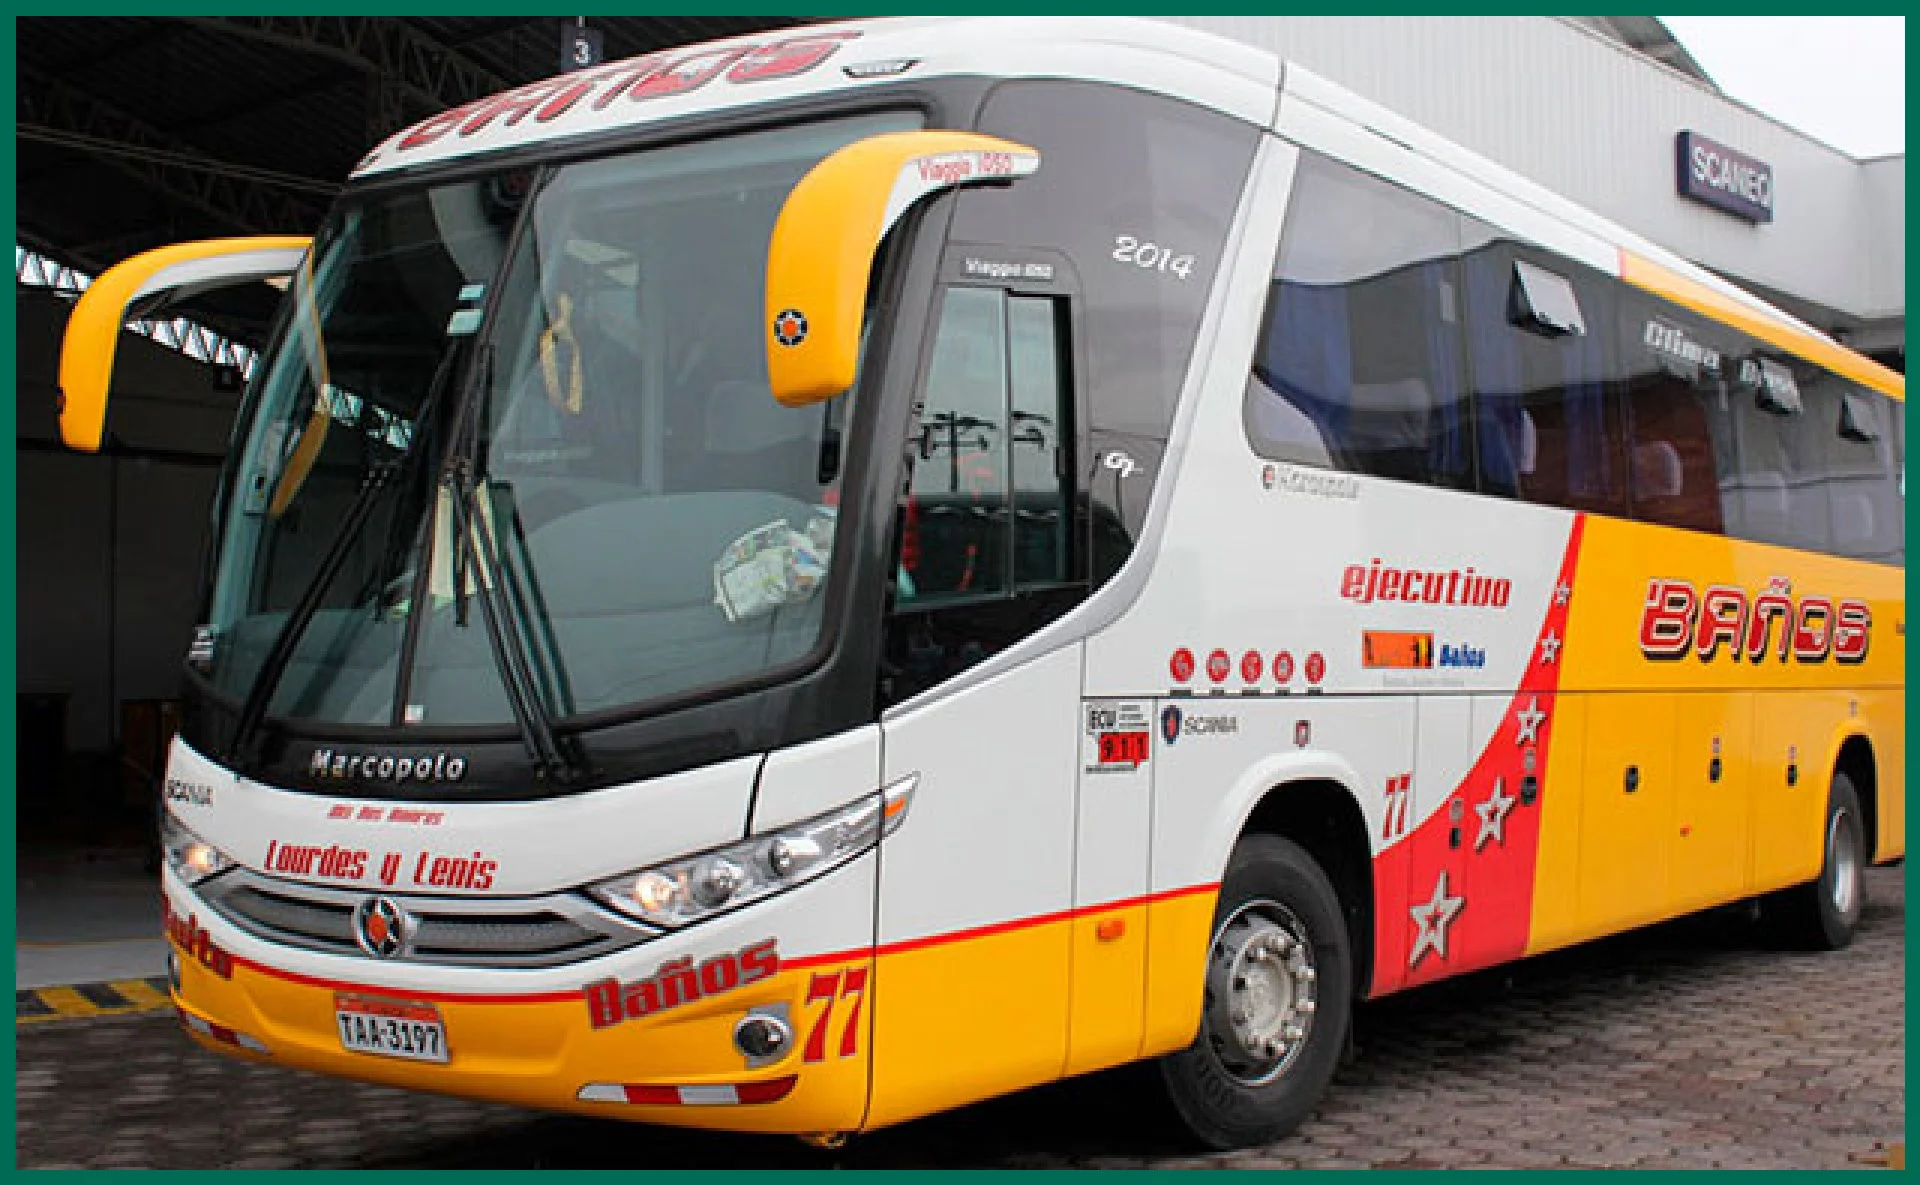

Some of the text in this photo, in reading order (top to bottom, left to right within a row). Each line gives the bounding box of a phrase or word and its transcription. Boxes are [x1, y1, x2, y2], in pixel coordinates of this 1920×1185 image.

[574, 39, 591, 66] 3
[1112, 235, 1195, 281] 2014
[1639, 577, 1872, 665] BAÑOS
[311, 750, 464, 782] Marcopolo
[1102, 739, 1147, 759] 911
[264, 840, 368, 879] Lourdes
[380, 852, 402, 885] y
[584, 938, 778, 1029] Baños
[339, 1013, 438, 1054] TAA-3197
[803, 967, 867, 1063] 77
